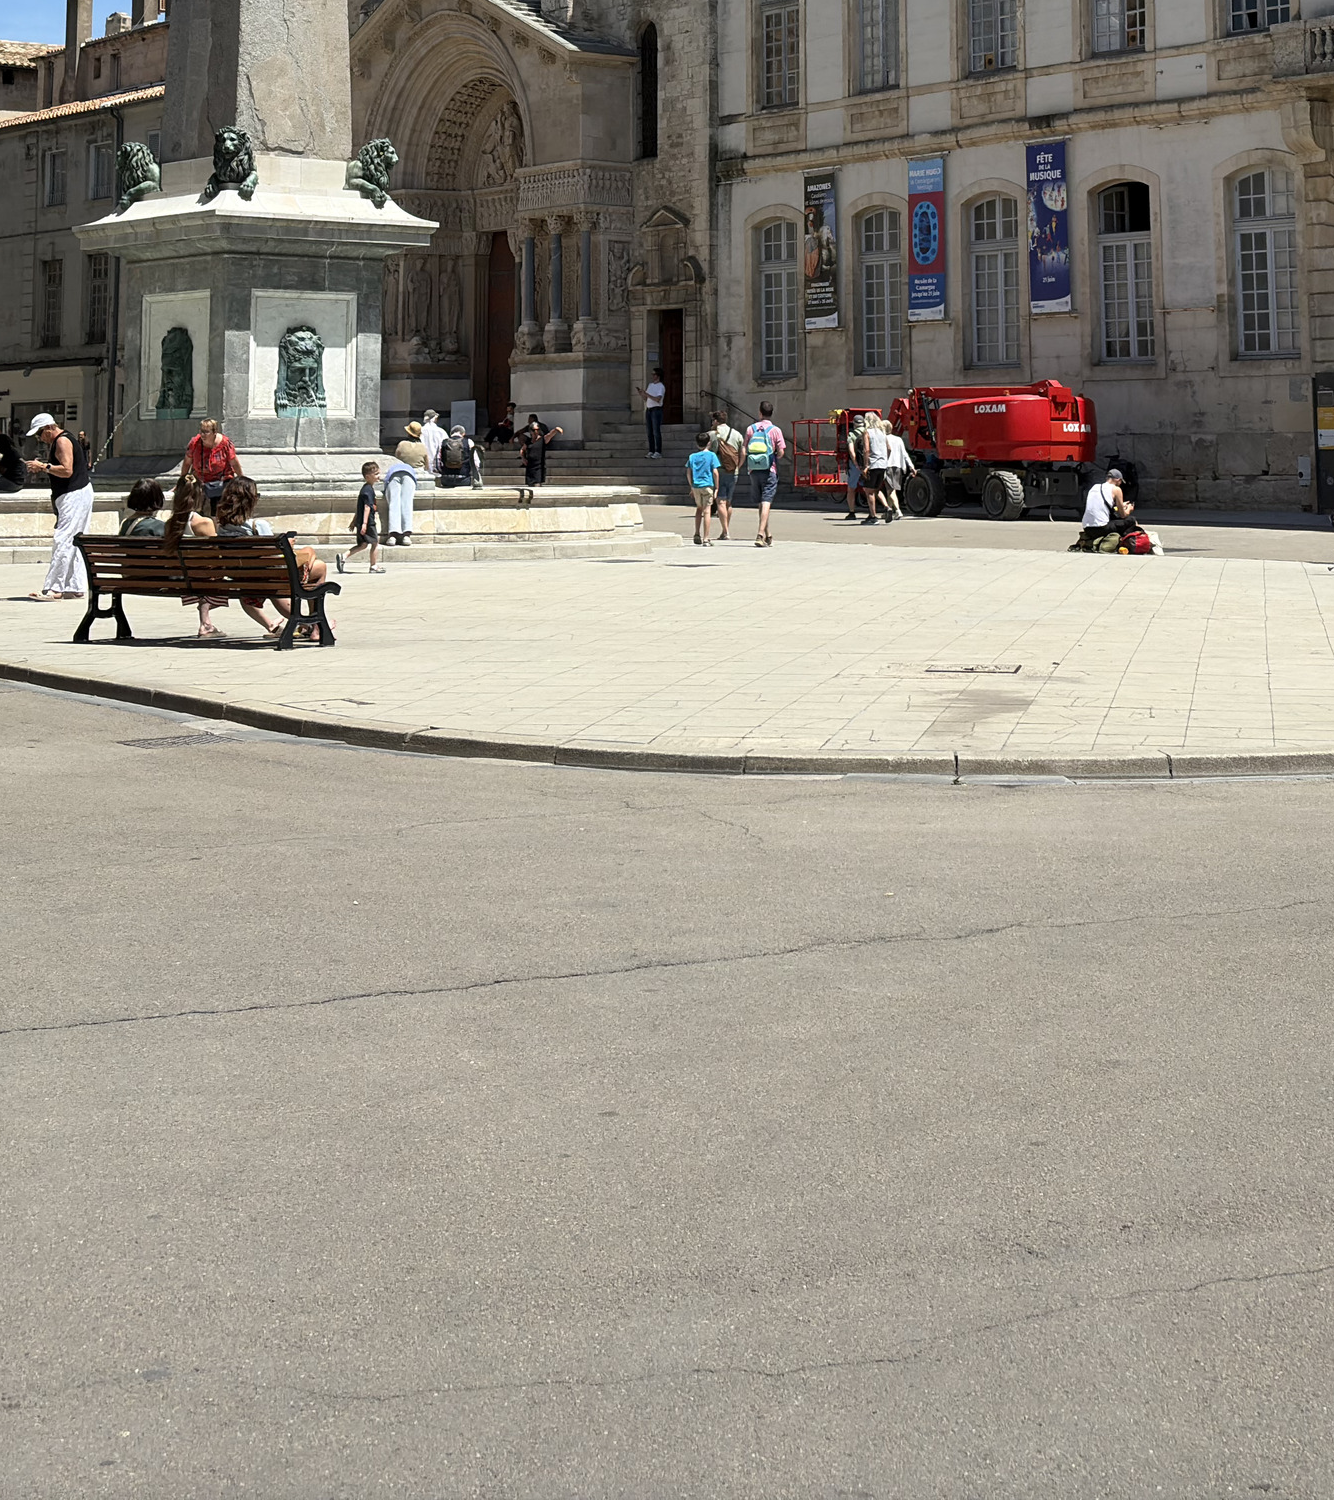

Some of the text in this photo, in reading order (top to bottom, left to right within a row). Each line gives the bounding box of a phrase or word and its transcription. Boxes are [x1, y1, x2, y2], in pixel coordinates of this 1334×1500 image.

[1037, 152, 1053, 163] FÊTE
[1030, 170, 1061, 181] MUSIQUE
[975, 404, 1006, 414] LOXAM
